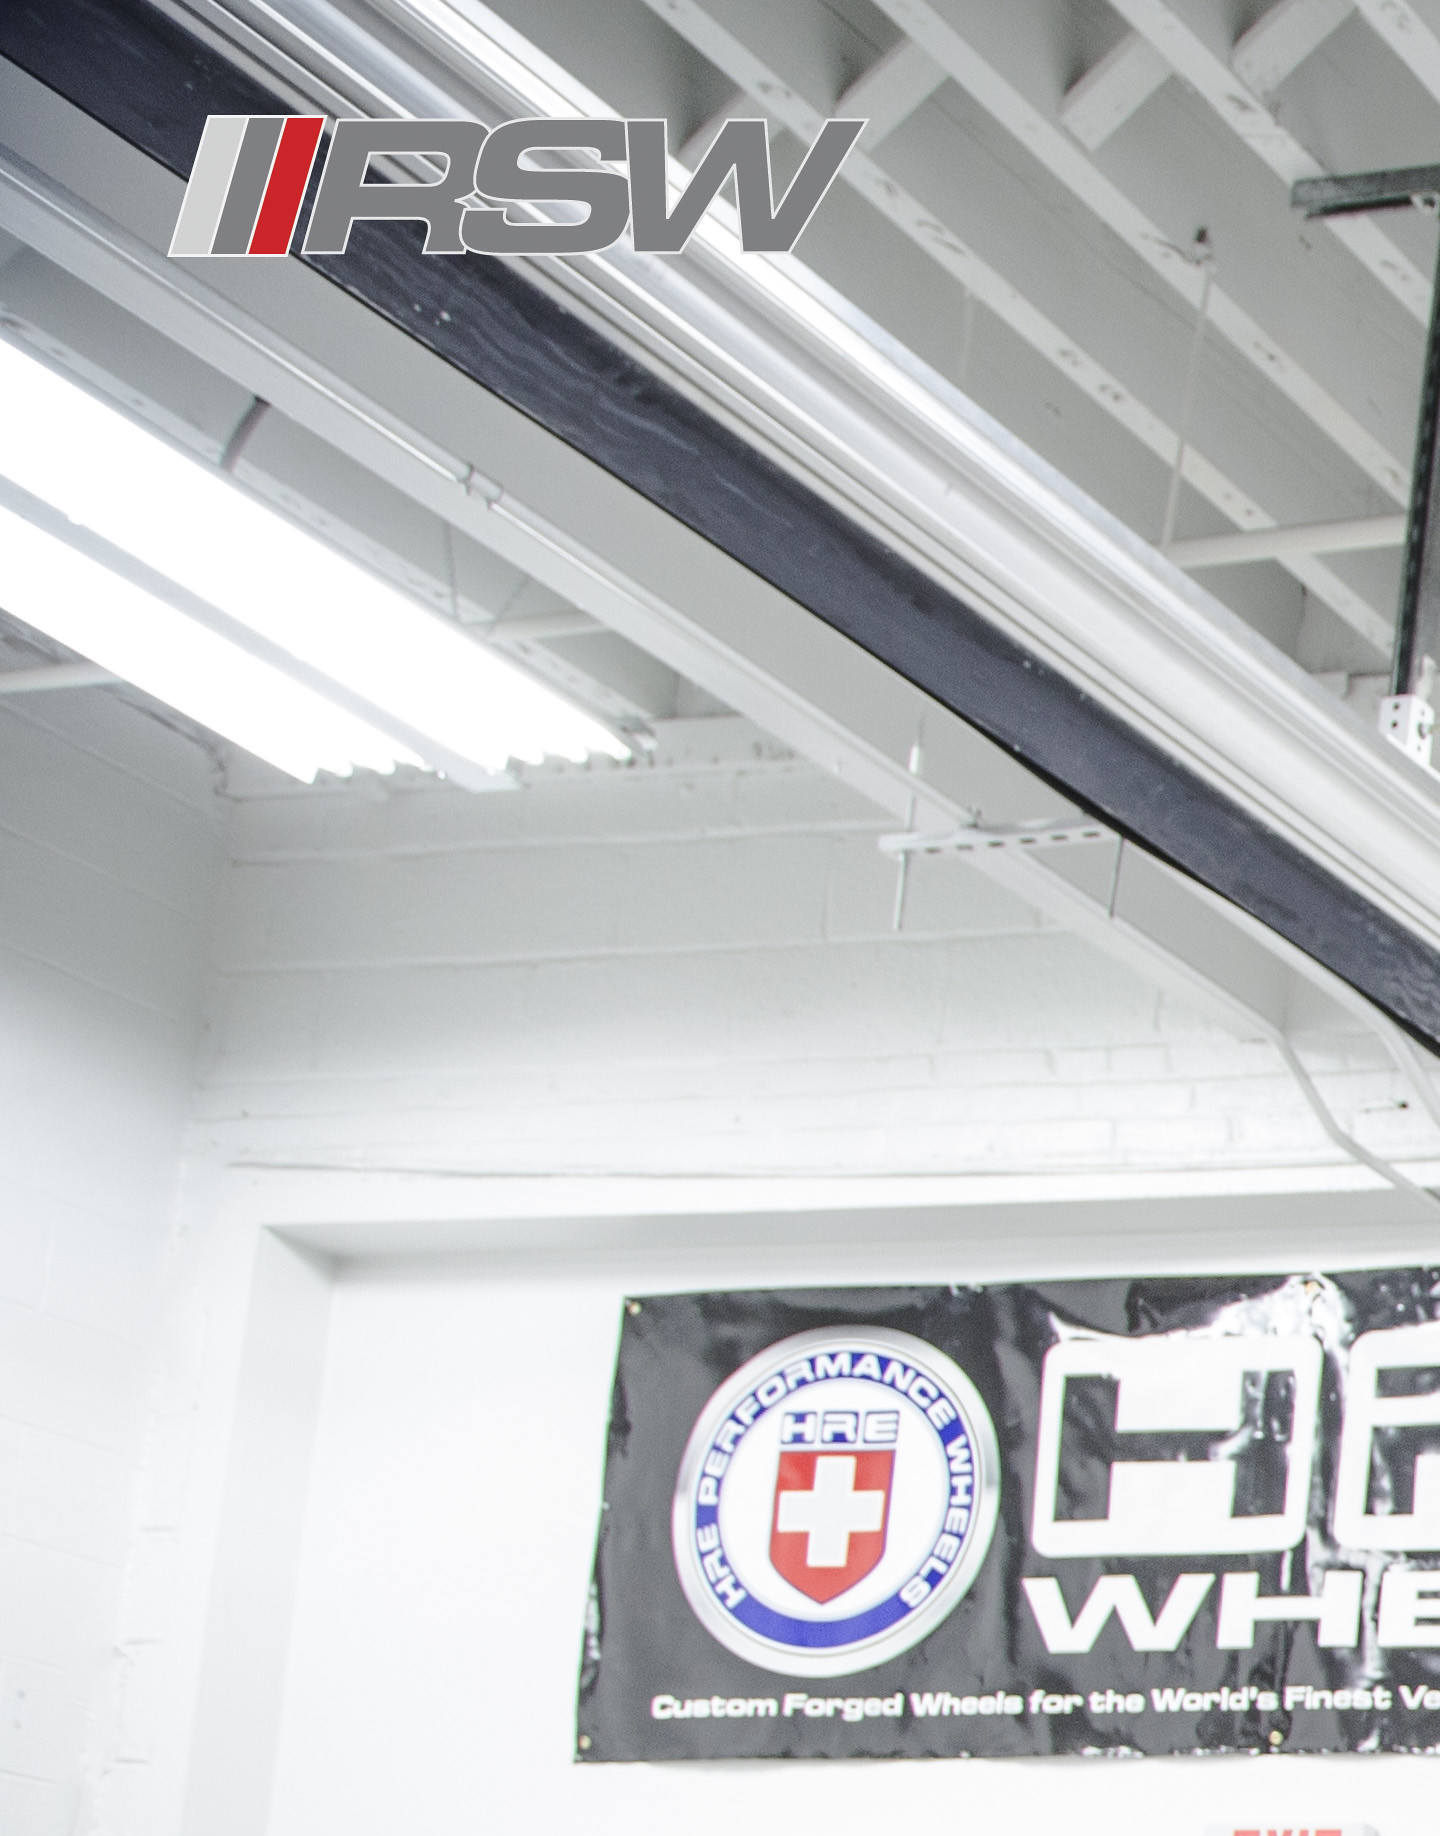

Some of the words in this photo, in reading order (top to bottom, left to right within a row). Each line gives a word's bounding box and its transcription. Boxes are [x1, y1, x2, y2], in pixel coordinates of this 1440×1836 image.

[697, 1350, 957, 1506] PERFORMANCE
[780, 1409, 900, 1445] HRE
[898, 1434, 974, 1609] WHEELS
[695, 1523, 748, 1610] HRE
[651, 1694, 778, 1719] Custom
[783, 1692, 903, 1722] Forged
[910, 1690, 1023, 1716] Wheels
[1029, 1689, 1084, 1715] for
[1088, 1689, 1145, 1714] the
[1151, 1687, 1279, 1712] World's
[1284, 1685, 1392, 1711] Finest
